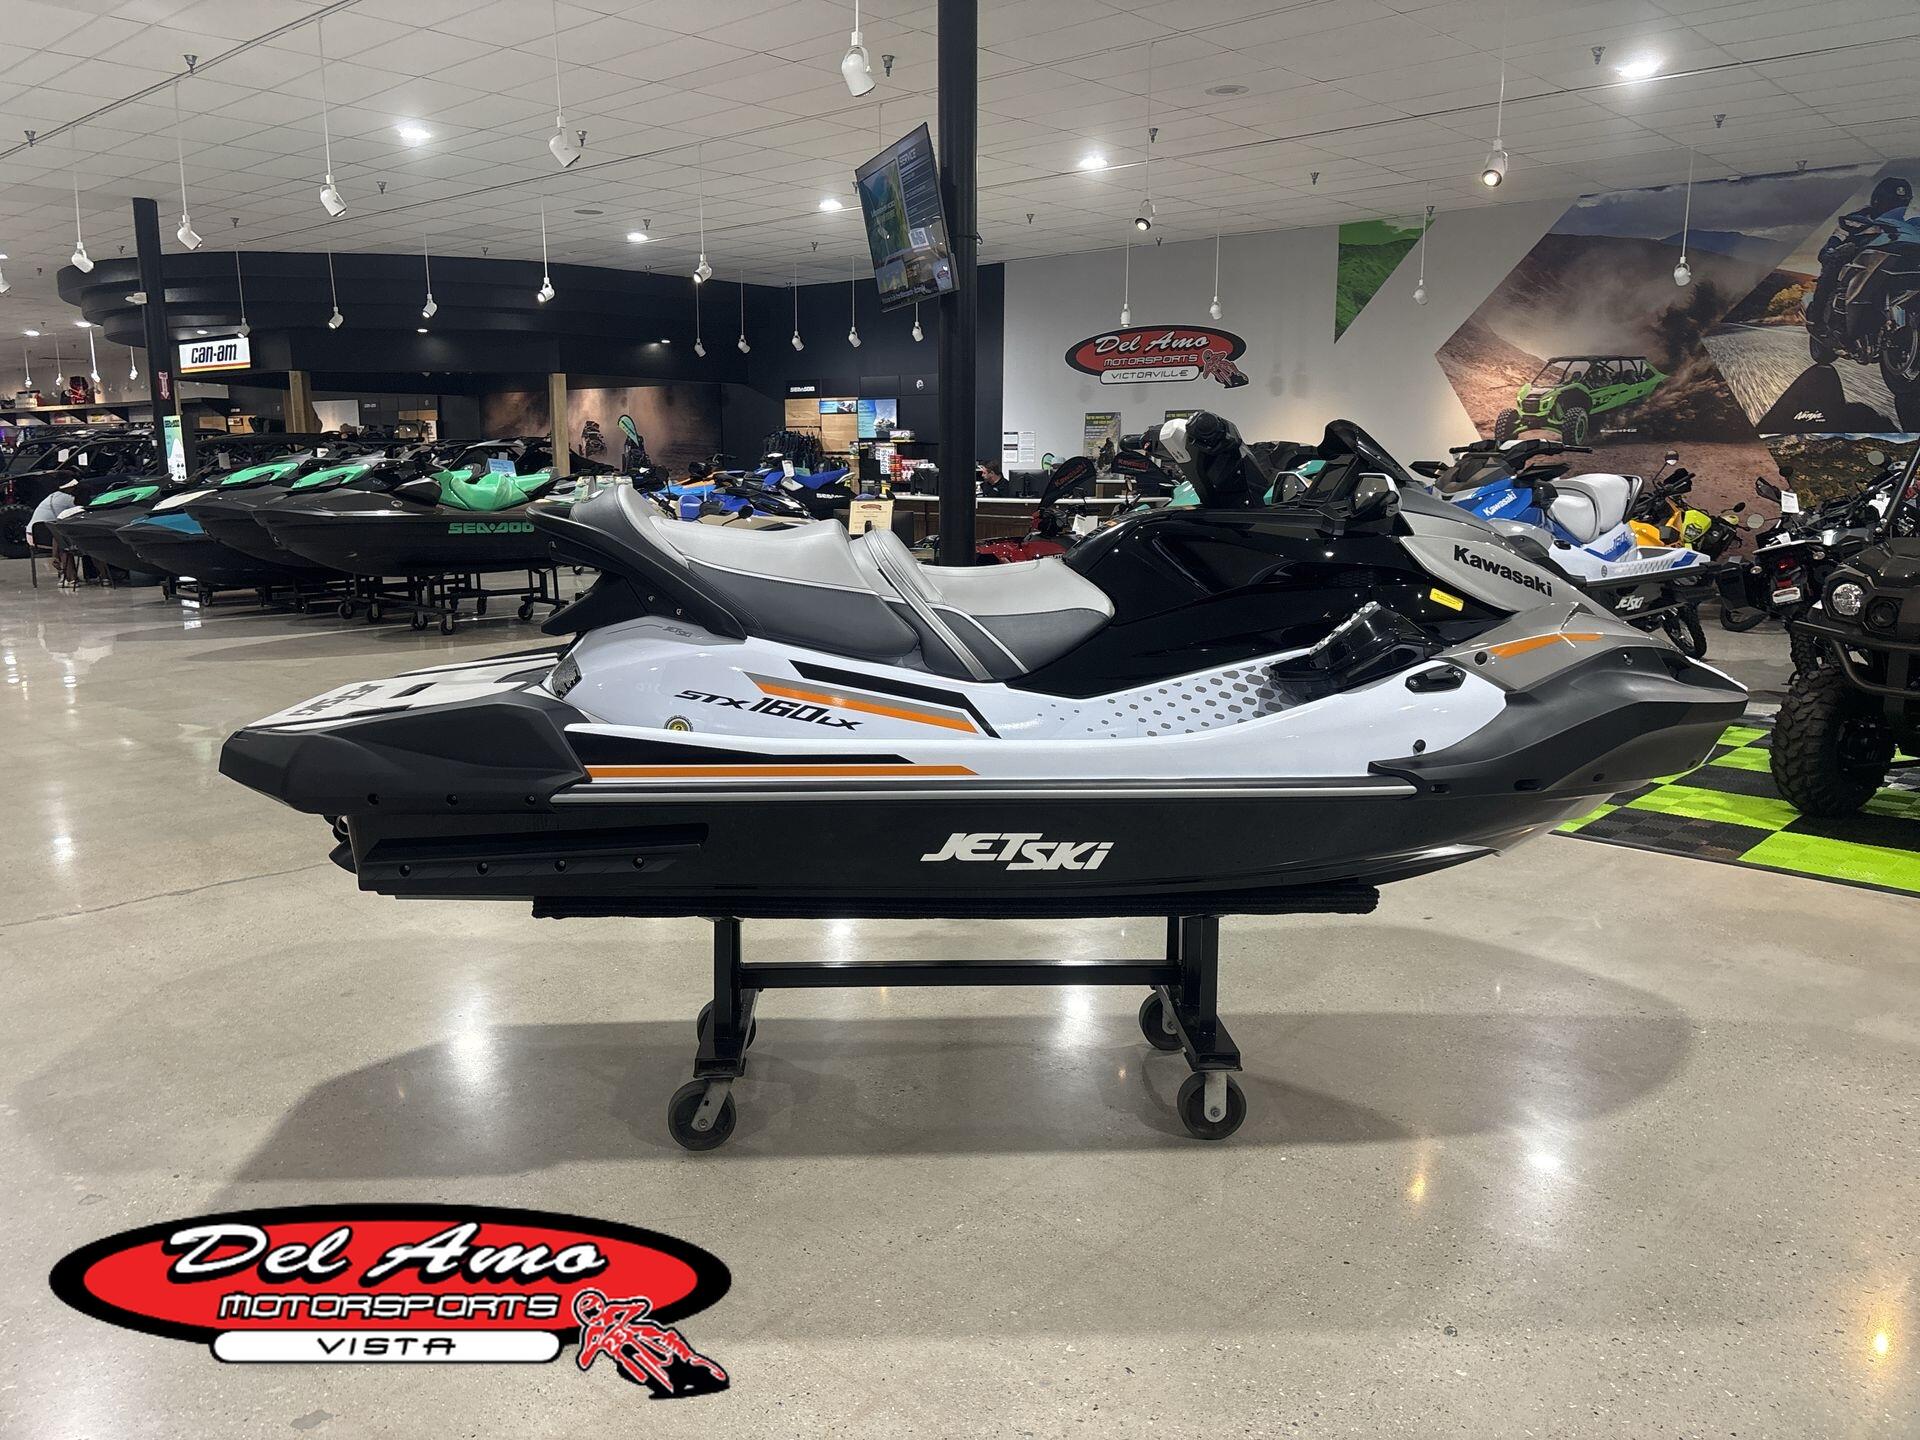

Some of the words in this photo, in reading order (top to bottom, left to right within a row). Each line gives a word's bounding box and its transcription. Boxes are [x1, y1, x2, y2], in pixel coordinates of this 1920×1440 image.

[1094, 335, 1142, 353] Del
[1144, 330, 1210, 352] Amo
[1103, 354, 1199, 367] MOTORSPORTS
[1111, 369, 1189, 380] VICTORVILLE
[1482, 490, 1518, 517] Kawasaki
[1453, 544, 1553, 598] Kawasaki
[674, 689, 750, 710] STX
